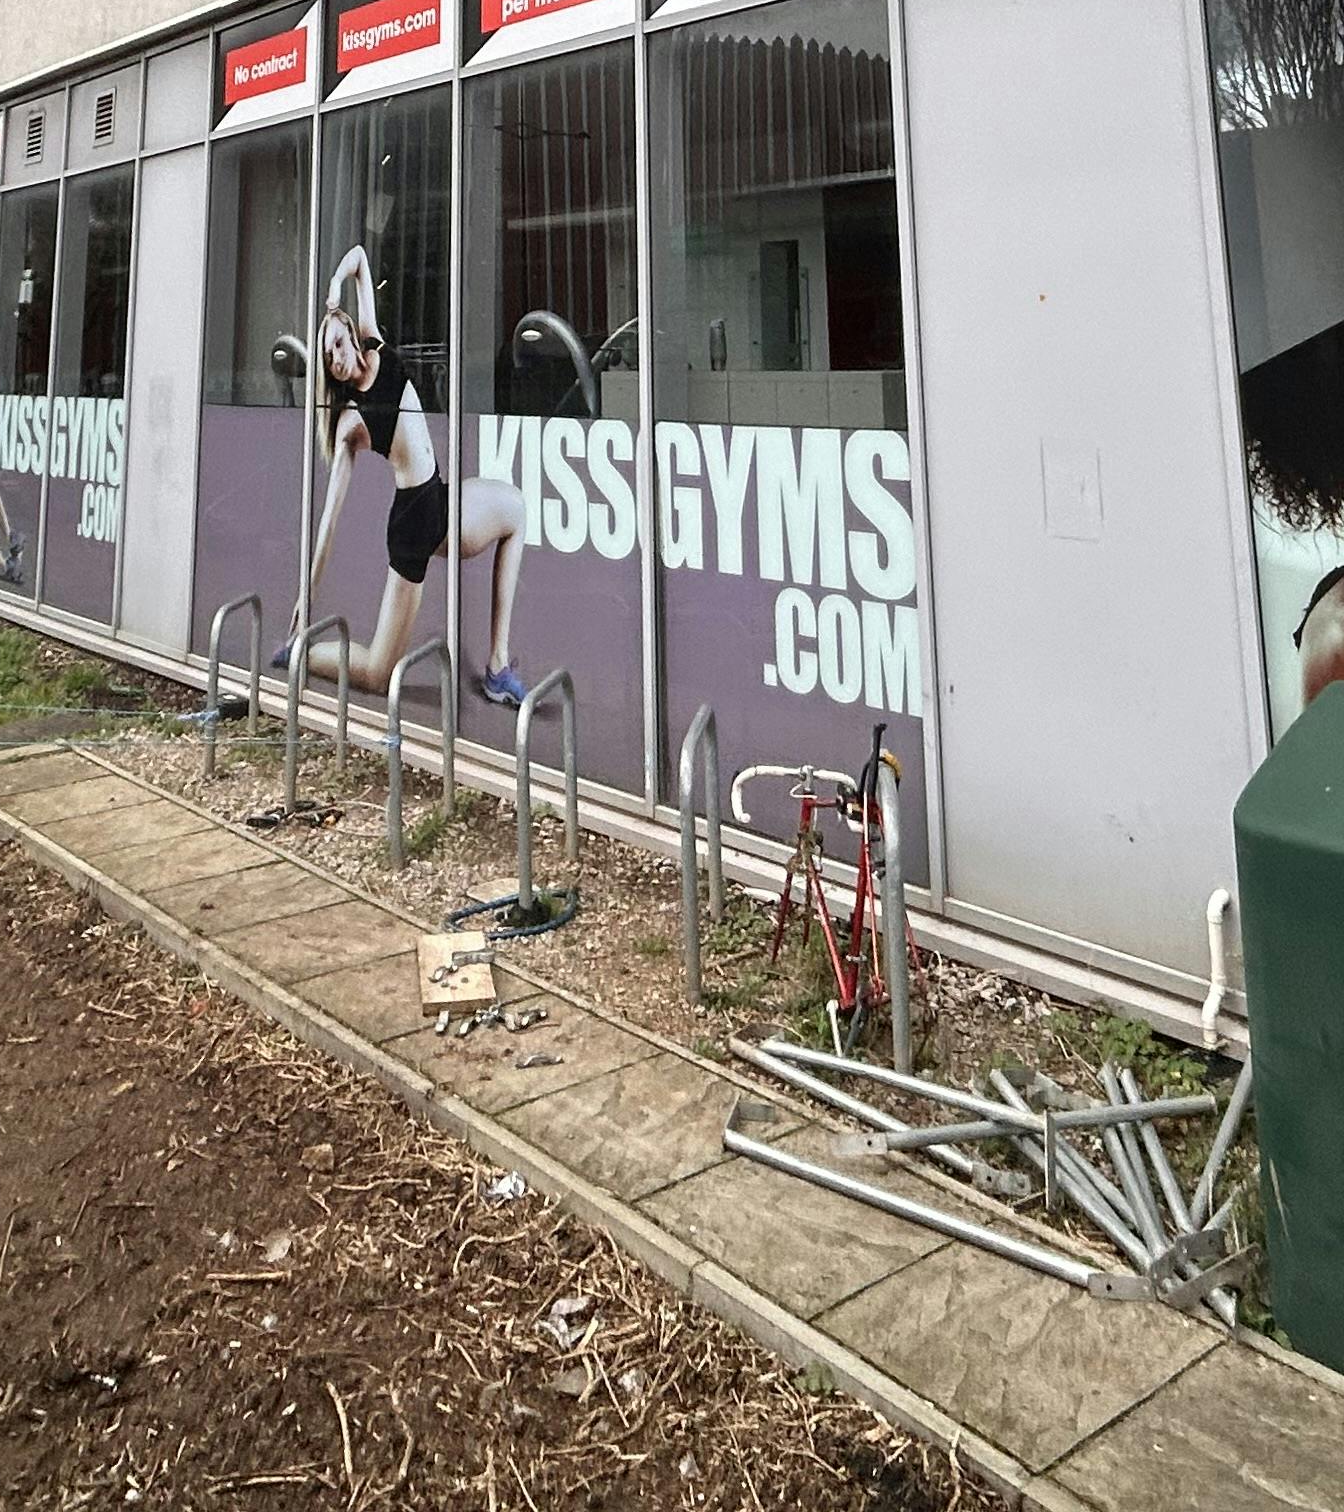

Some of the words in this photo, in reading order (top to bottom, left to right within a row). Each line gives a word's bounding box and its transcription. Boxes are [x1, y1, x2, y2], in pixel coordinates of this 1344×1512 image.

[341, 7, 436, 52] kissgyms.com
[234, 65, 250, 86] No
[251, 48, 298, 79] contract
[763, 587, 923, 717] .COM
